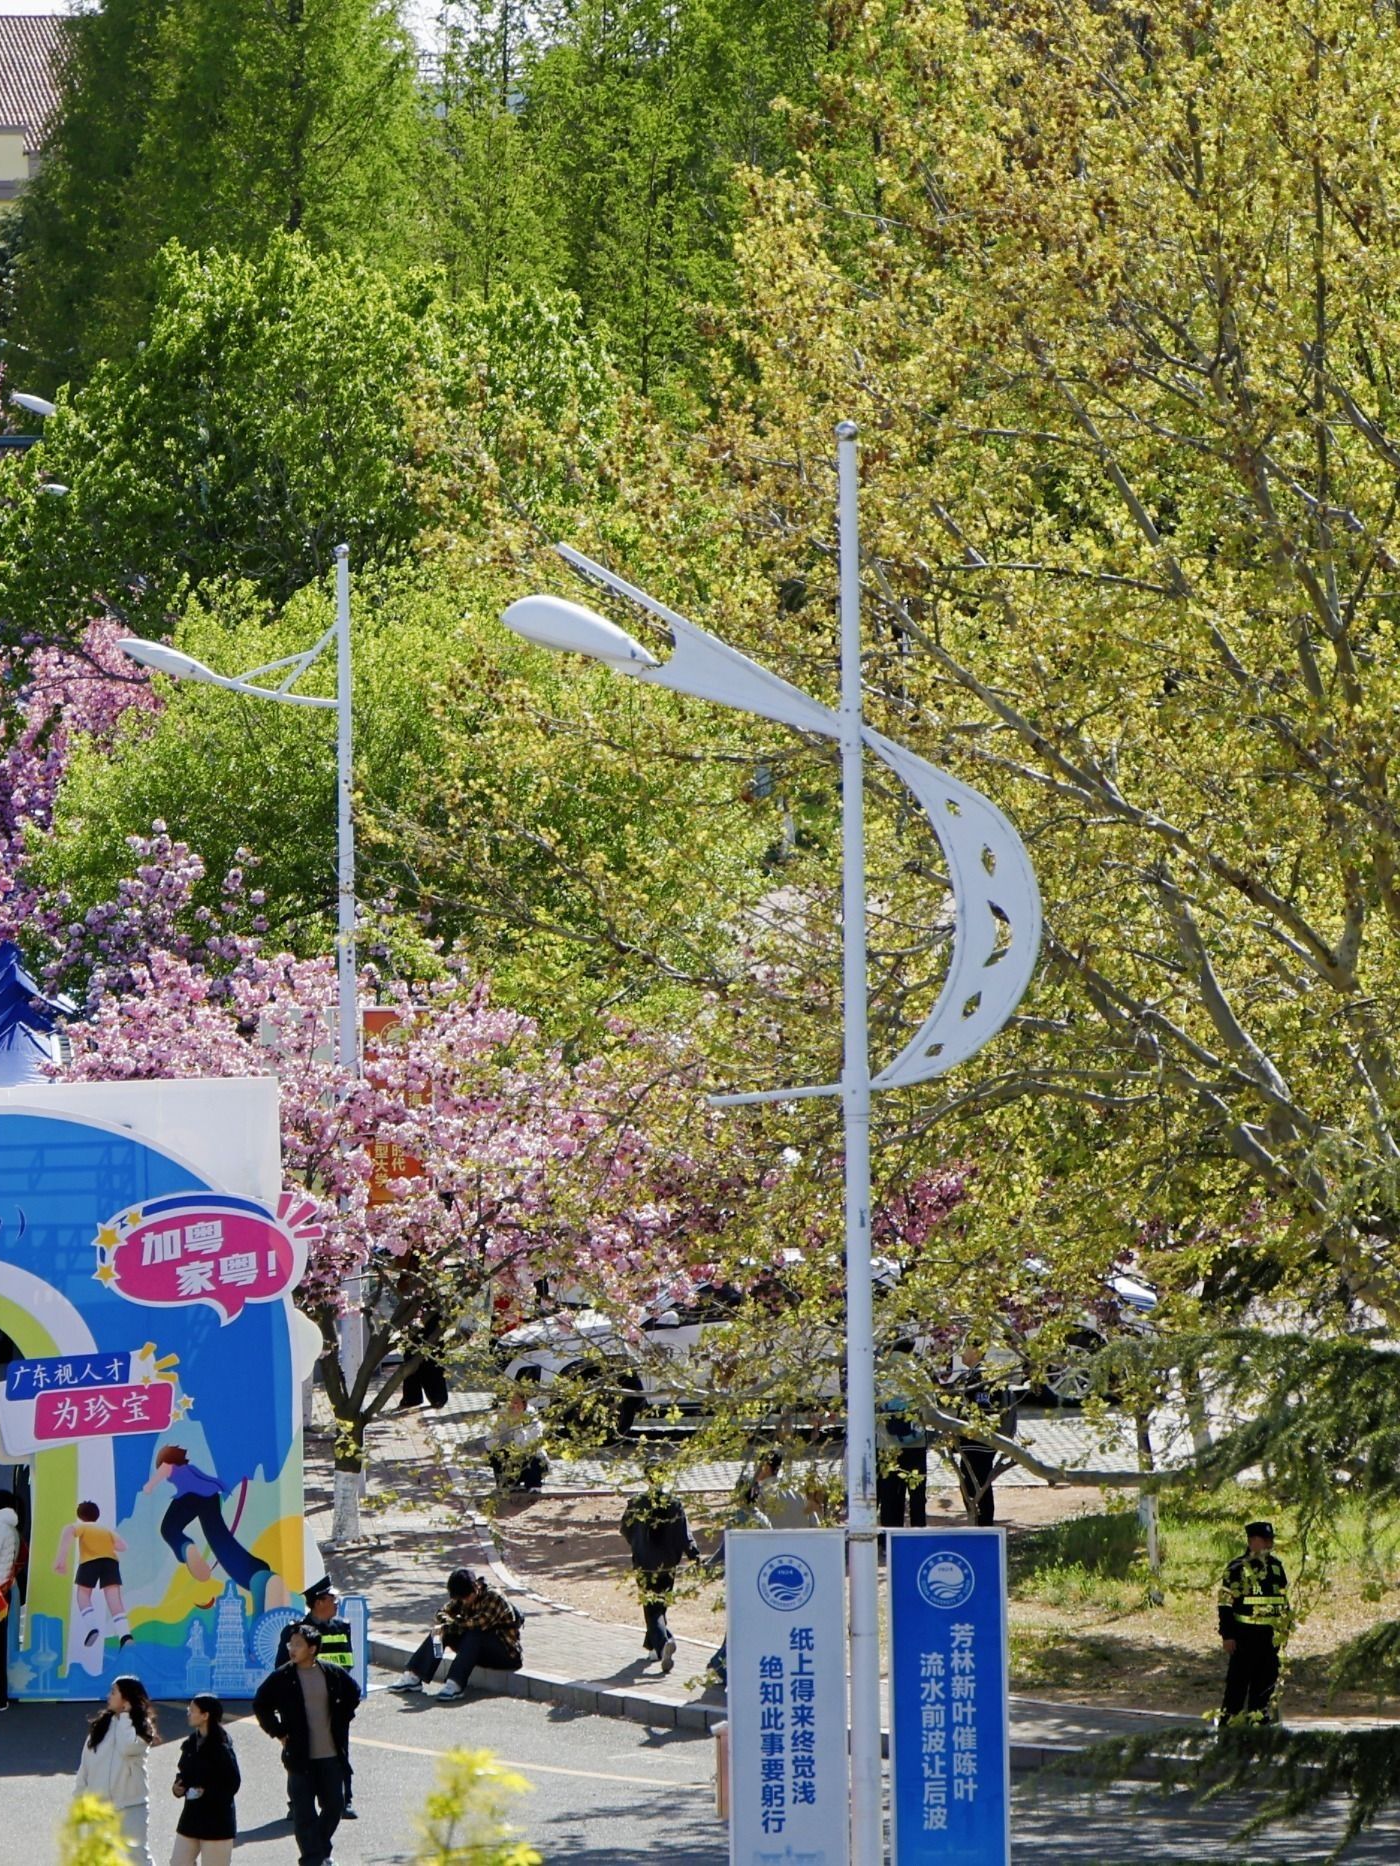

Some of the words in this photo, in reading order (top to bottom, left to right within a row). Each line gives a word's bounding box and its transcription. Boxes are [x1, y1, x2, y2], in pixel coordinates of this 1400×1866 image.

[141, 1219, 224, 1266] 加粤
[11, 1358, 124, 1391] 广东视人才
[52, 1391, 151, 1431] 为珍宝
[759, 1655, 787, 1834] 绝知此事要躬行
[789, 1626, 816, 1806] 纸上得来终觉浅
[920, 1652, 948, 1831] 流水前波让后波
[950, 1623, 978, 1802] 芳林新叶催陈叶
